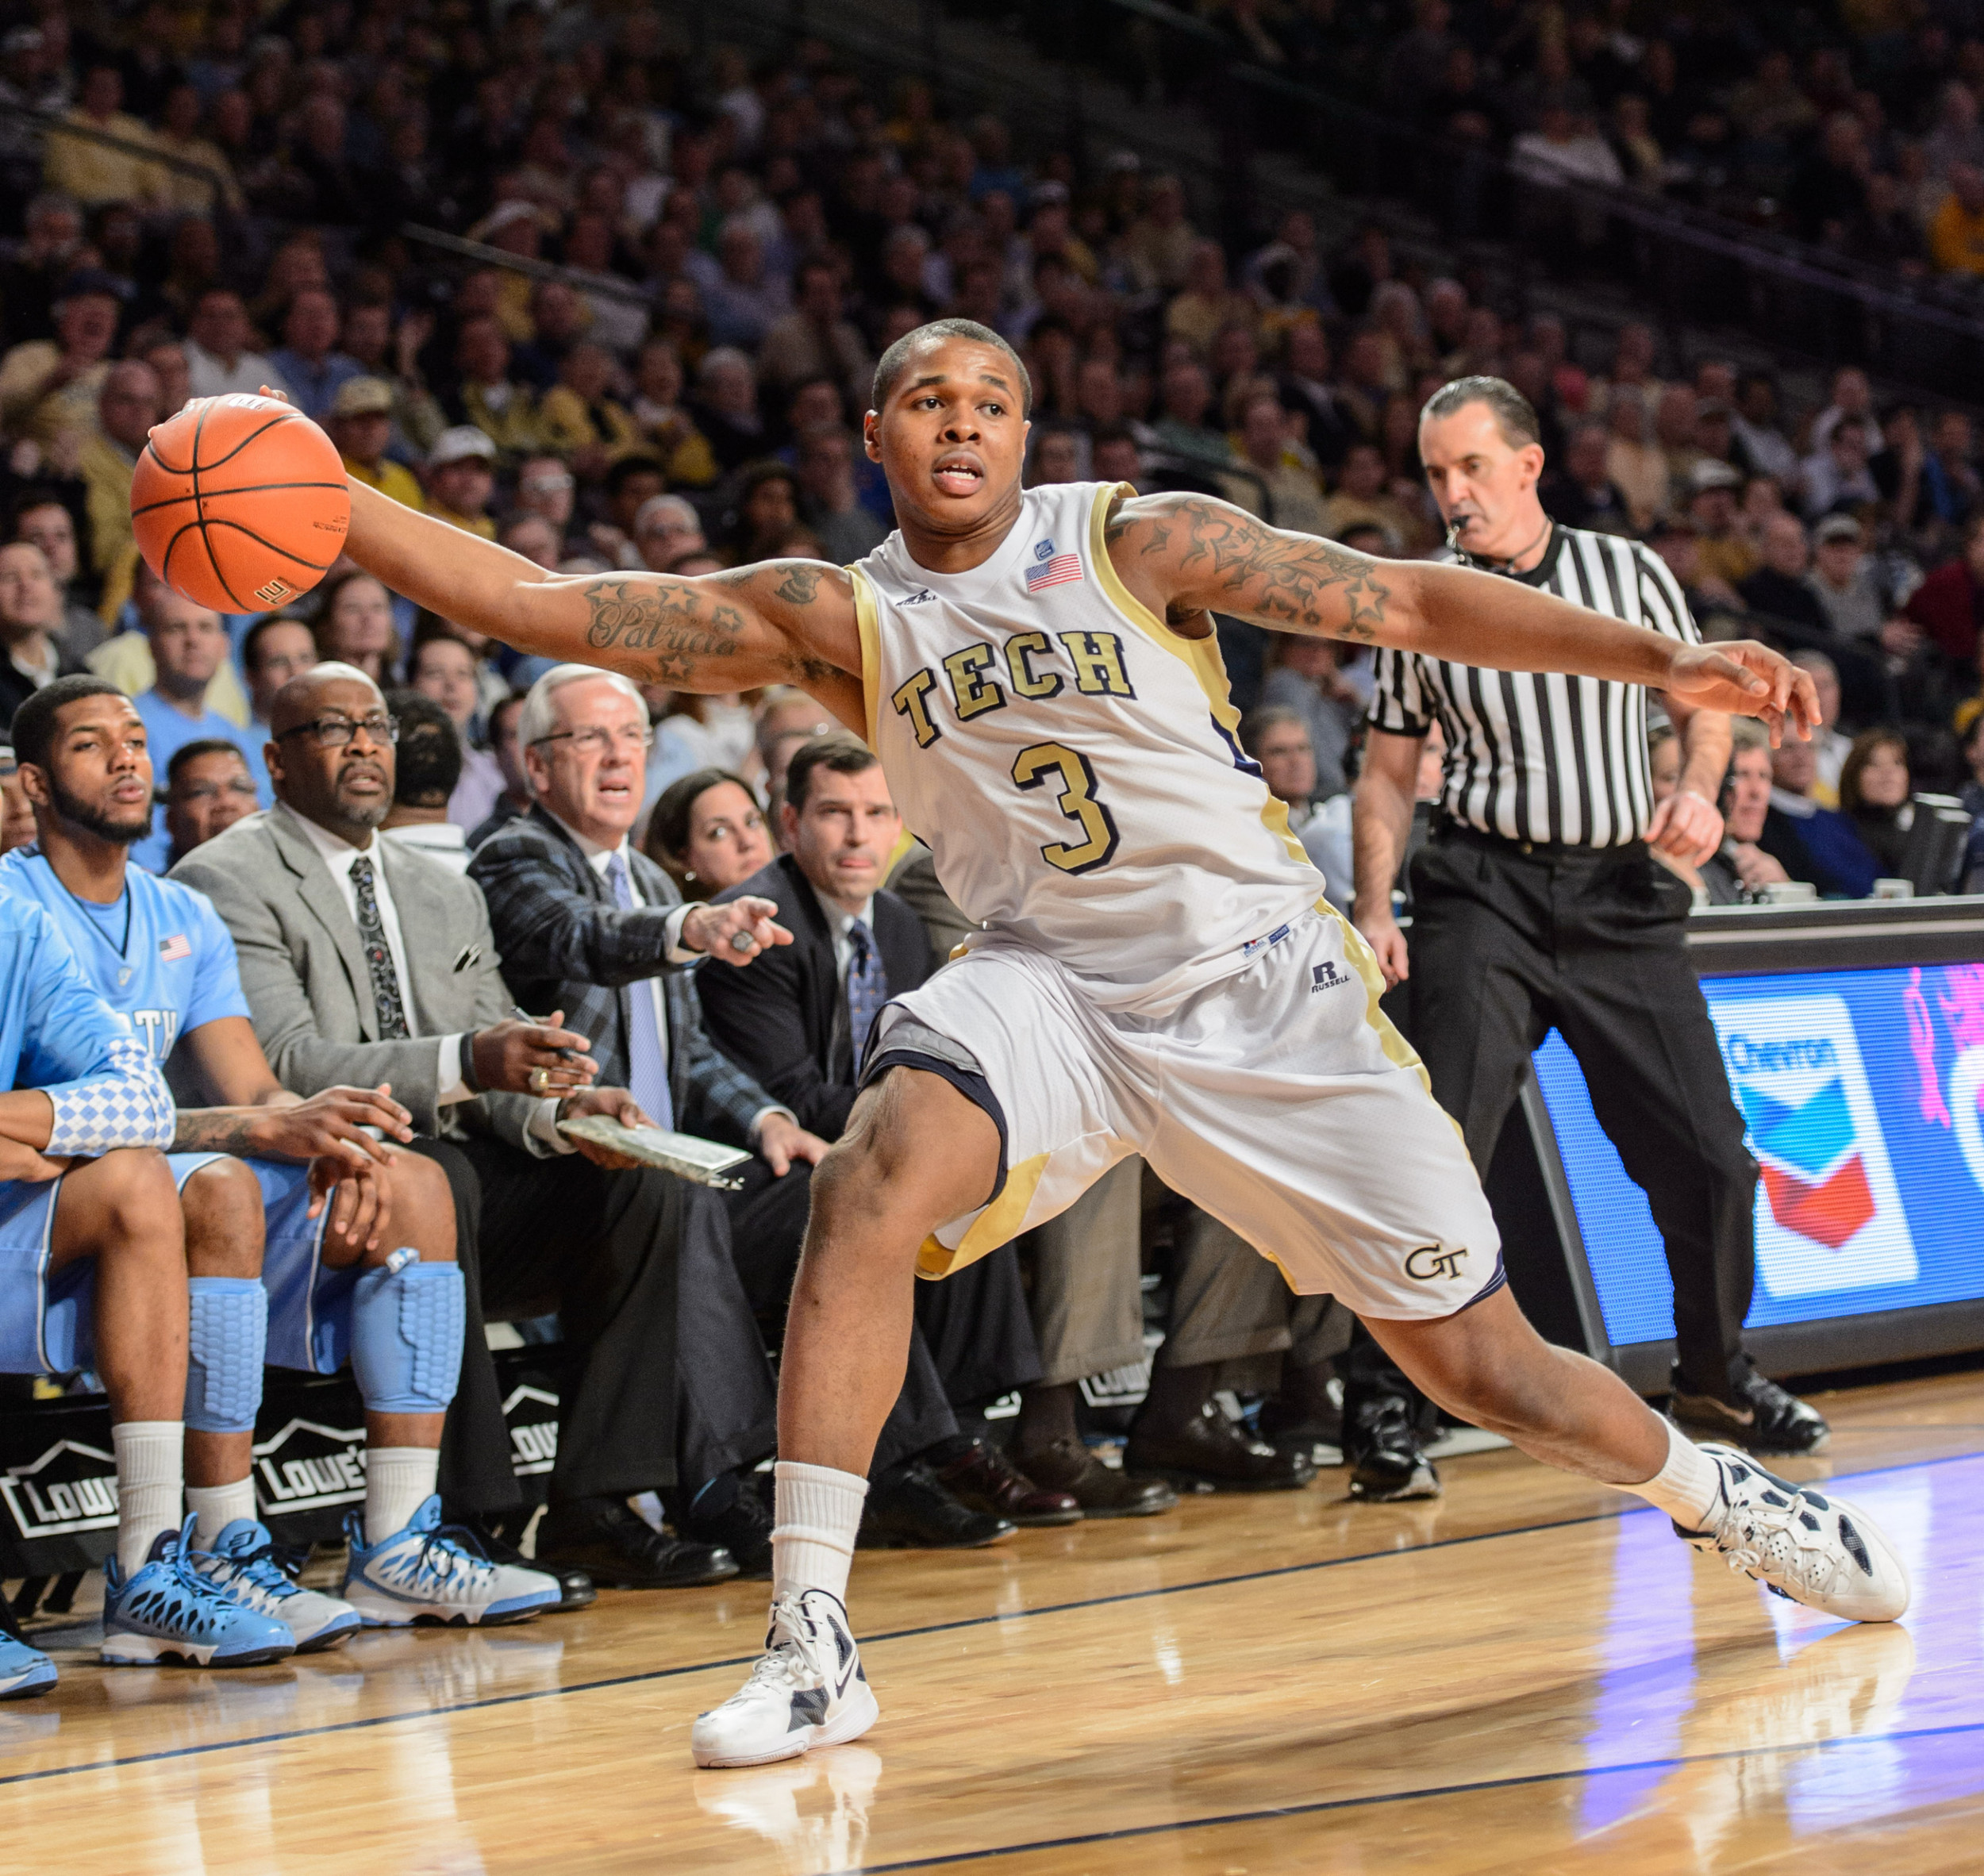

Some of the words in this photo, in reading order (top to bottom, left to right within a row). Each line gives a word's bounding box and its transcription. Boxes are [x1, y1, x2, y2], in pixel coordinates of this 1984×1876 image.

[586, 597, 737, 657] Patricia
[892, 631, 1137, 749] TECH
[1012, 741, 1121, 875] 3
[1312, 975, 1351, 994] RUSSELL
[1313, 961, 1337, 984] R
[1728, 1034, 1836, 1074] Chevron
[1403, 1243, 1469, 1282] GT
